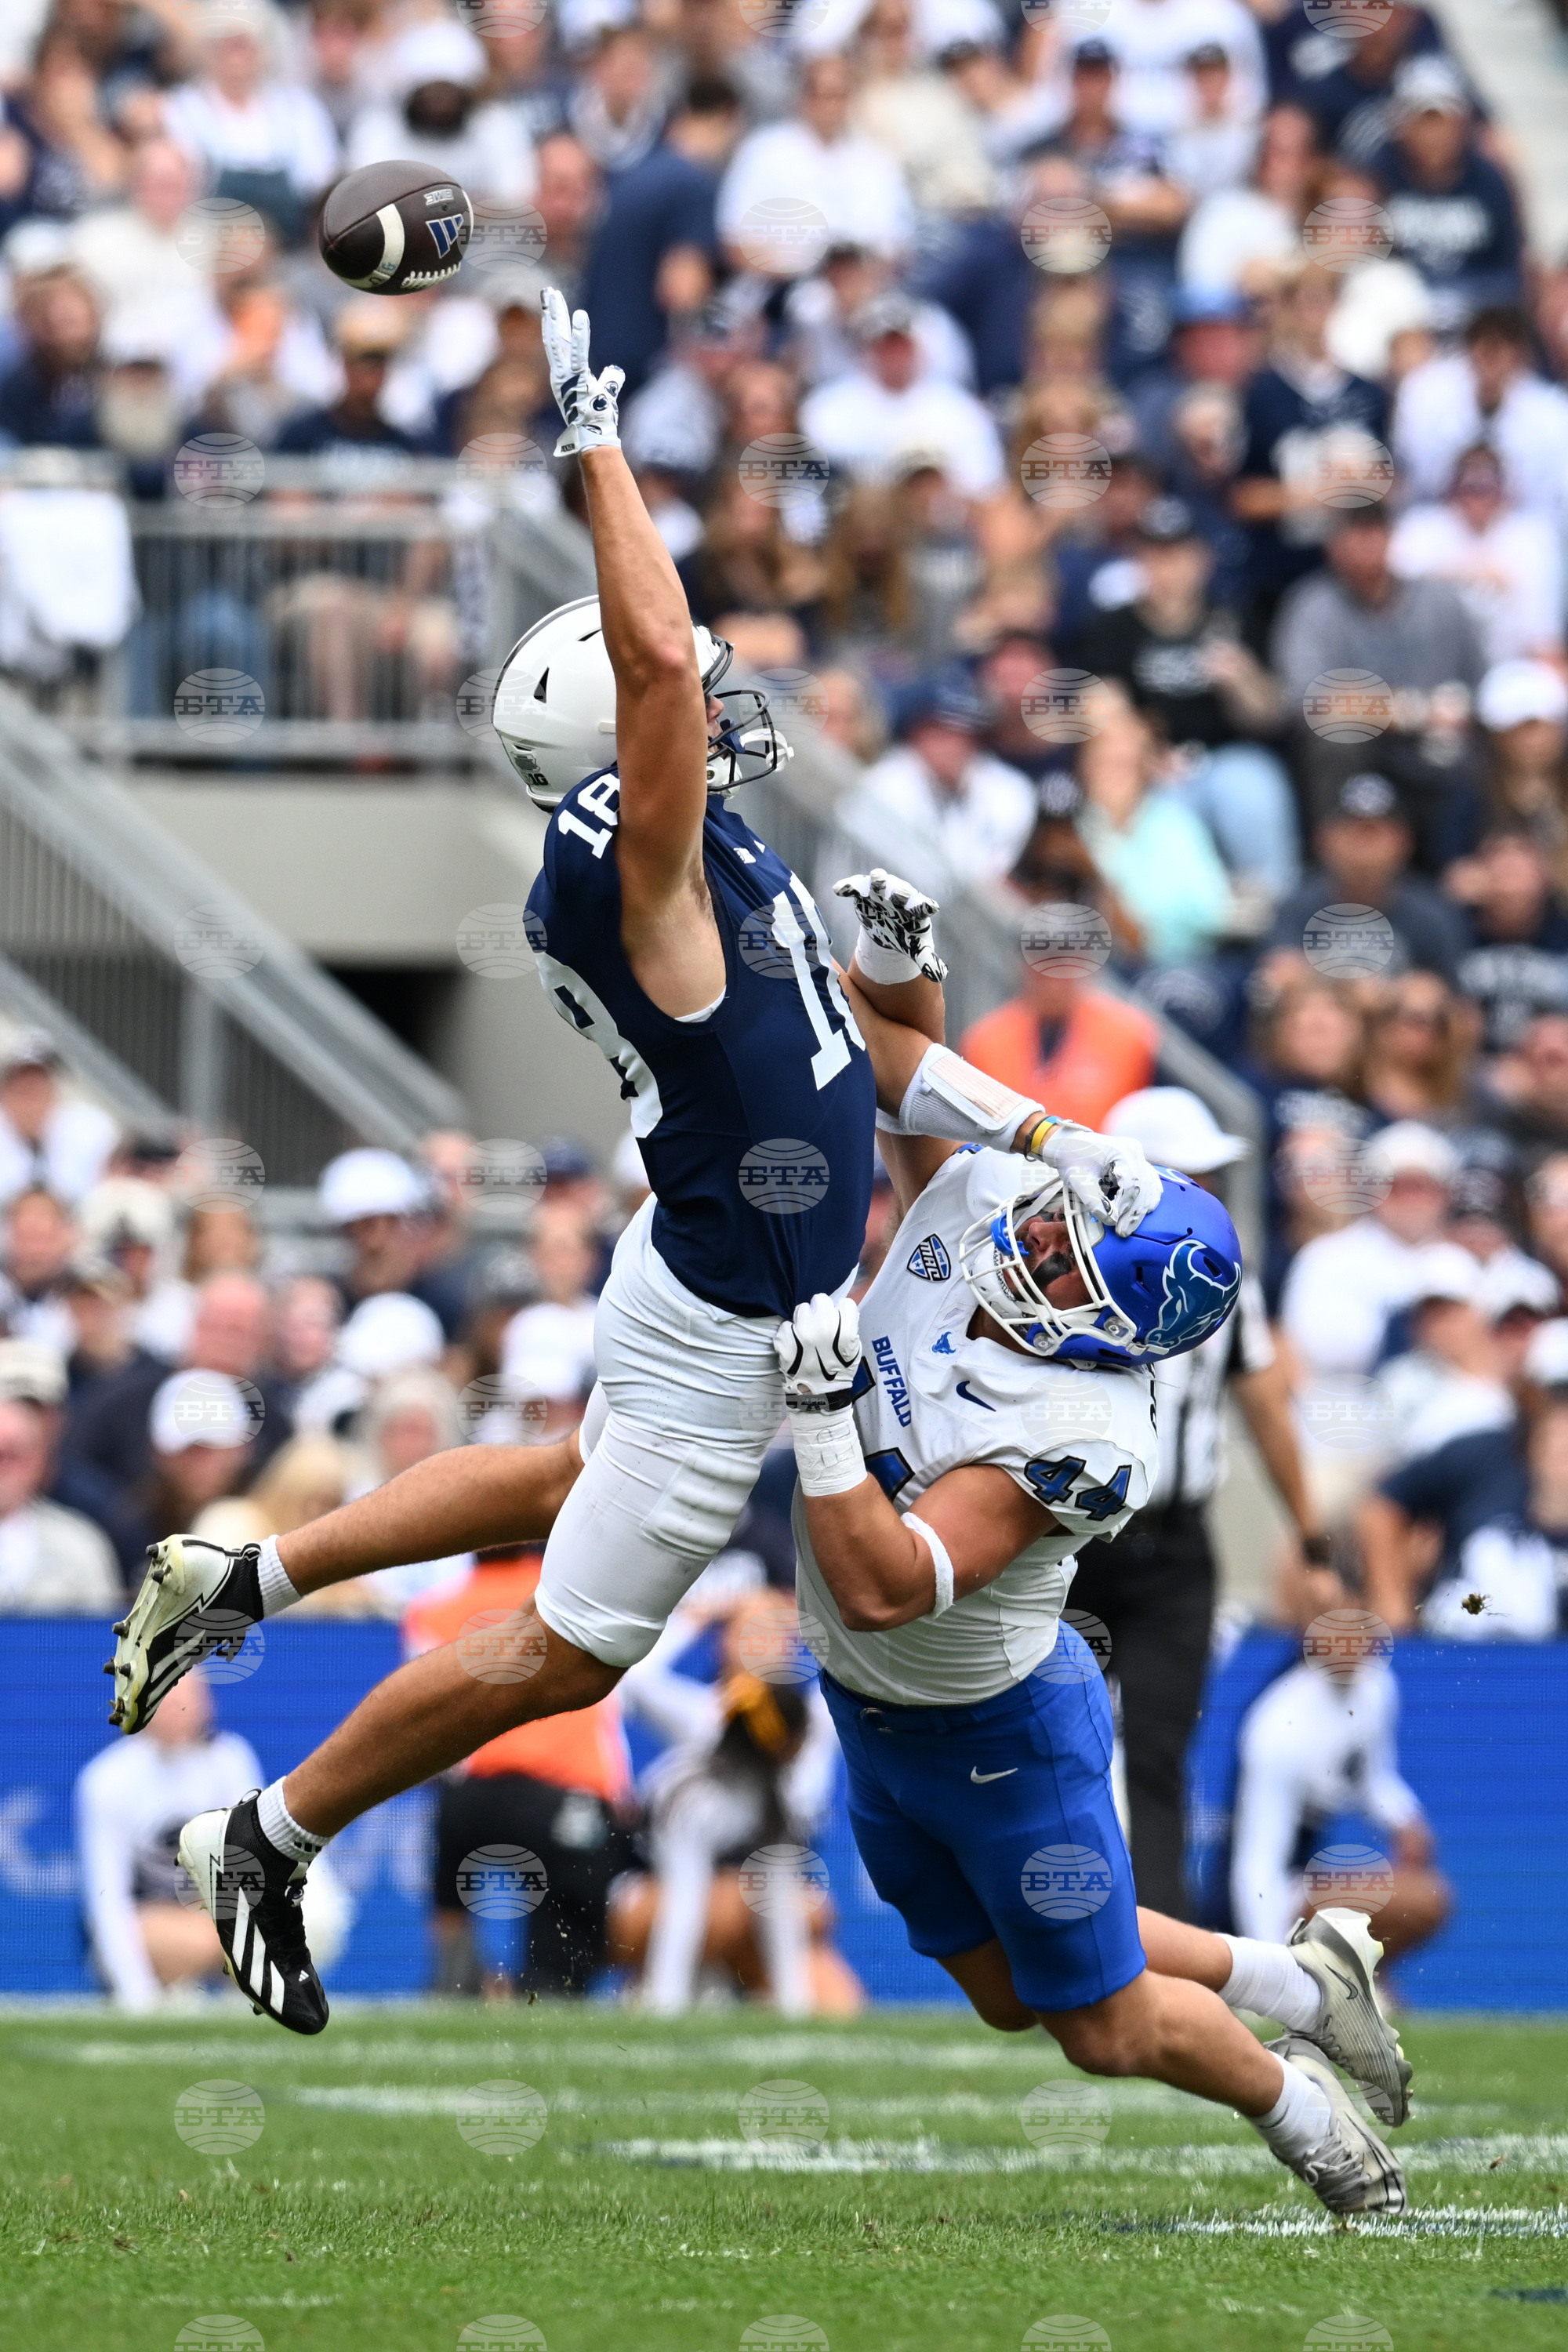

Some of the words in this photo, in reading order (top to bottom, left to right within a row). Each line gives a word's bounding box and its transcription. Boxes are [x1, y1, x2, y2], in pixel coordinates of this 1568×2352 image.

[557, 773, 622, 859] 18
[872, 1335, 912, 1428] BUFFALO
[1024, 1455, 1132, 1521] 44
